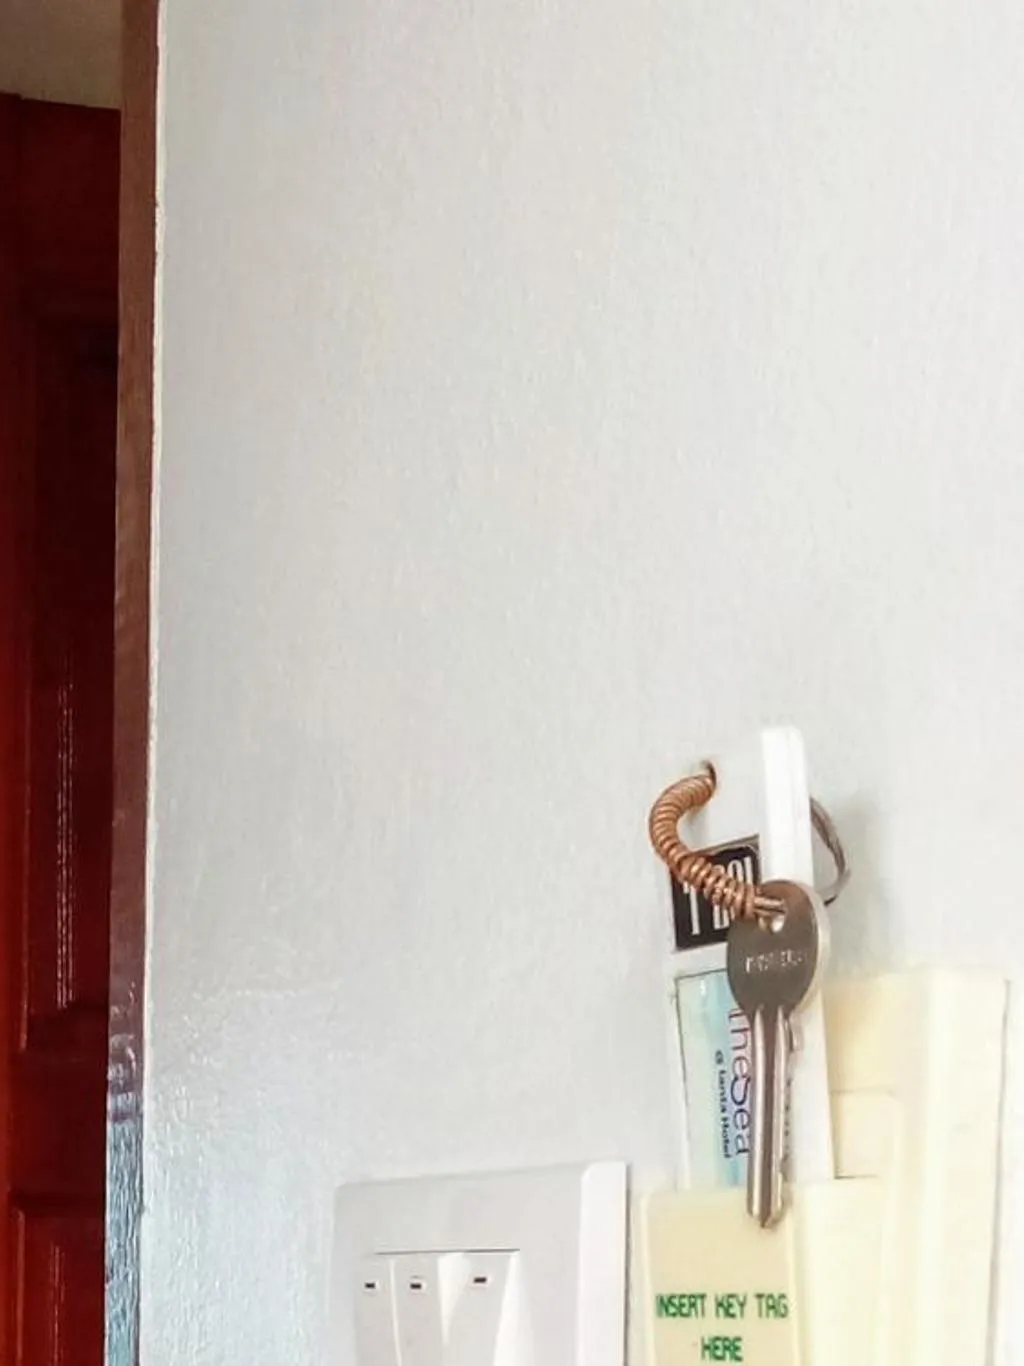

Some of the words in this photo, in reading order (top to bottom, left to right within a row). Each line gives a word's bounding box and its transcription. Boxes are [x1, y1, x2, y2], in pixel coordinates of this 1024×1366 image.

[656, 1292, 707, 1319] INSERT
[714, 1292, 747, 1319] KEY
[753, 1292, 789, 1319] TAG
[700, 1336, 744, 1362] HERE
